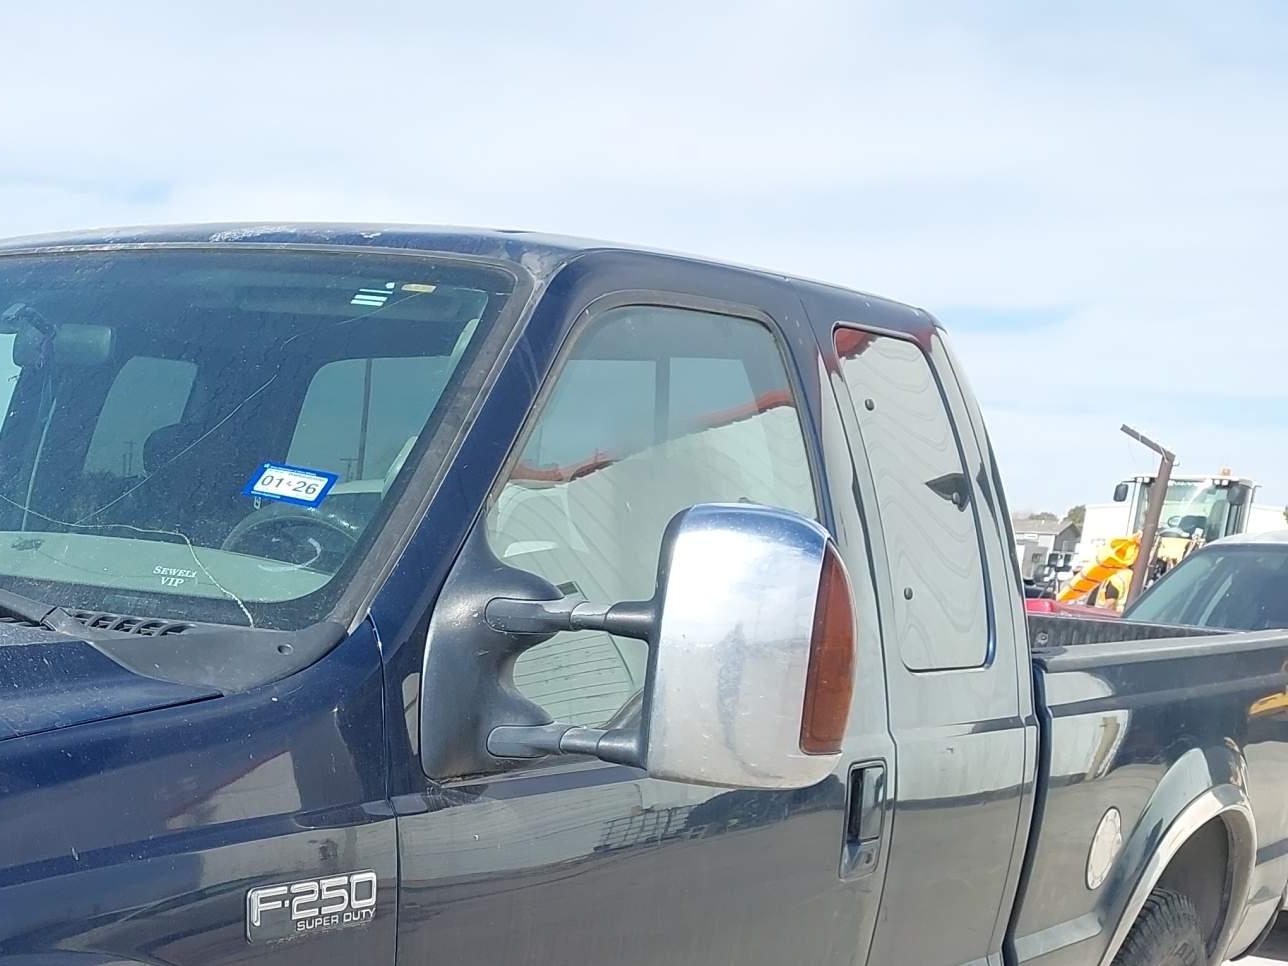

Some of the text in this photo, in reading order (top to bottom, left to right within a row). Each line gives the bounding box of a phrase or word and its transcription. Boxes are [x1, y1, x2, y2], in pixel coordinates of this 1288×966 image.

[261, 475, 284, 488] 01
[293, 480, 320, 495] 26
[161, 576, 185, 587] VIP
[296, 907, 377, 932] SUPER DUTY
